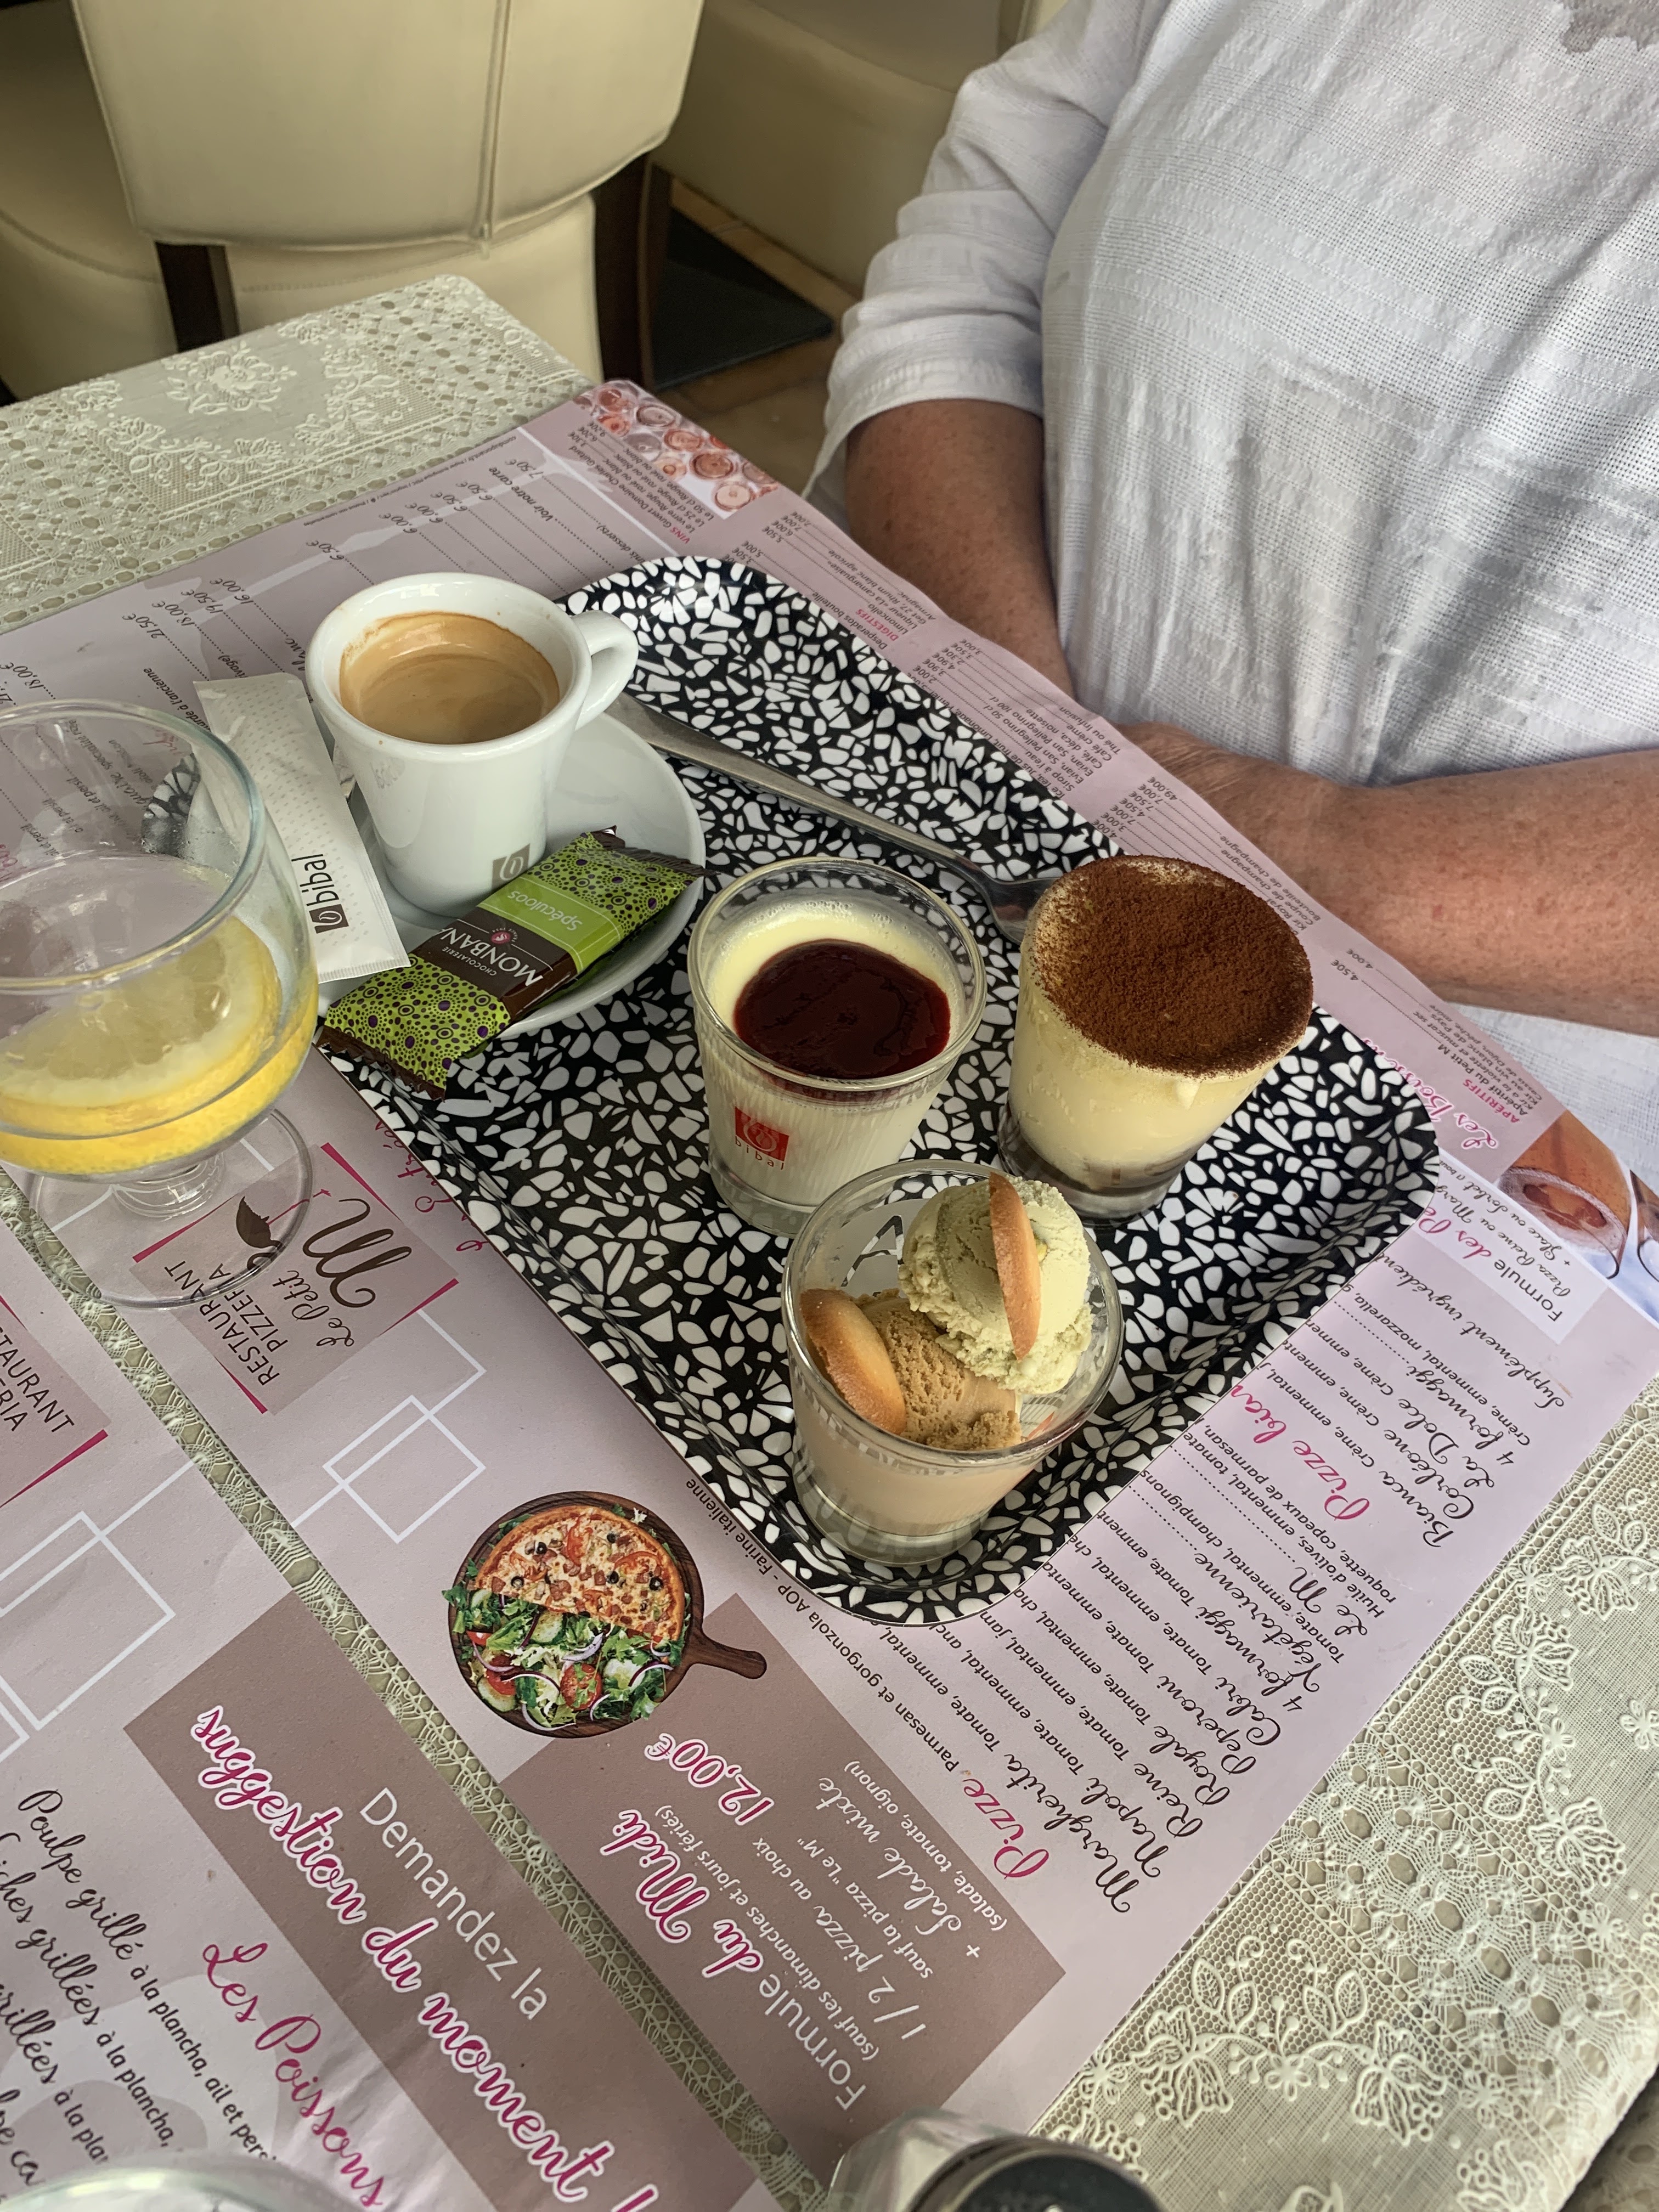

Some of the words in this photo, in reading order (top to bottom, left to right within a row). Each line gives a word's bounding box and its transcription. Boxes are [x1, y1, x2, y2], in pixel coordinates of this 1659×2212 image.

[488, 467, 514, 489] carte
[510, 483, 538, 508] notre
[532, 505, 553, 522] Voir
[843, 614, 888, 650] Desperados
[855, 608, 899, 643] DIGESTIFS
[1002, 718, 1043, 752] Pellegrino
[1012, 711, 1053, 744] Pellegrino
[1058, 706, 1093, 734] Infusion
[1042, 749, 1059, 764] San
[1052, 742, 1069, 757] San
[1081, 749, 1102, 769] Café,
[1092, 744, 1114, 764] Café
[1104, 740, 1121, 754] Thé
[1051, 771, 1075, 792] Sirop
[291, 854, 339, 906] bibal
[506, 878, 583, 932] Spéculoos
[441, 942, 497, 977] CHOCOLATERIE
[1330, 959, 1358, 981] 4,50€
[1451, 1053, 1474, 1074] Petit
[1463, 1079, 1520, 1123] APÉRITIFS
[1488, 1085, 1528, 1115] Apéritif
[735, 1135, 785, 1170] bibal
[1451, 1111, 1499, 1152] Les
[1462, 1181, 1508, 1214] Sorbet
[300, 1196, 413, 1310] M
[1456, 1229, 1492, 1260] des
[1497, 1232, 1535, 1266] Reine
[271, 1269, 330, 1322] Petit
[1493, 1259, 1563, 1322] Formule
[1537, 1263, 1571, 1297] Pizza
[314, 1317, 355, 1348] Le
[1353, 1292, 1422, 1351] mozzarella,
[1352, 1357, 1393, 1396] Crème,
[1421, 1349, 1488, 1406] emmental,
[1458, 1320, 1565, 1409] Supplément
[1266, 1368, 1332, 1426] emmental,
[1338, 1386, 1380, 1426] Crème,
[1404, 1364, 1504, 1451] formaggi
[1333, 1425, 1375, 1468] Crème,
[1396, 1397, 1459, 1465] Dolce
[1490, 1404, 1531, 1446] Crème,
[1203, 1424, 1269, 1485] parmesan,
[1289, 1439, 1370, 1522] Pizze
[1381, 1429, 1475, 1520] Corléone
[1460, 1455, 1495, 1489] La
[685, 1478, 737, 1536] italienne
[1227, 1472, 1296, 1536] emmental,
[1265, 1484, 1283, 1500] de
[1376, 1470, 1454, 1548] Bianca
[1281, 1500, 1336, 1550] copeaux
[735, 1532, 773, 1575] Farine
[1297, 1535, 1347, 1583] d'olives,
[1339, 1549, 1397, 1603] roquette,
[777, 1584, 810, 1612] AOP
[1090, 1556, 1160, 1622] emmental,
[1148, 1557, 1195, 1607] Tomate,
[1221, 1547, 1292, 1616] emmental,
[1287, 1566, 1328, 1613] M
[1346, 1583, 1385, 1618] Huile
[1104, 1620, 1155, 1674] Tomate,
[1171, 1552, 1340, 1693] Végétarienne
[1294, 1611, 1345, 1664] Tomate,
[1332, 1604, 1368, 1638] Le
[808, 1610, 883, 1687] gorgonzola
[878, 1623, 949, 1695] emmental,
[1004, 1636, 1076, 1705] emmental,
[1161, 1621, 1212, 1675] Tomate,
[1193, 1605, 1299, 1697] formaggi
[877, 1686, 895, 1703] et
[1103, 1673, 1151, 1725] Tomate,
[1212, 1676, 1282, 1747] Cabri
[893, 1702, 960, 1772] Parmesan
[949, 1695, 1001, 1752] Tomate,
[1032, 1718, 1085, 1775] Tomate,
[1077, 1705, 1130, 1761] Tomate,
[1154, 1674, 1260, 1776] Peperoni
[644, 1729, 775, 1828] 12,00€
[843, 1760, 899, 1814] oignon)
[1147, 1724, 1231, 1807] Royale
[814, 1776, 881, 1844] mixte
[1131, 1762, 1204, 1839] Reine
[654, 1804, 703, 1852] fériés)
[900, 1813, 952, 1872] tomate,
[932, 1778, 1050, 1881] Pizze
[977, 1753, 1159, 1914] Margherita
[1076, 1776, 1178, 1878] Napoli
[16, 1788, 88, 1884] Poulpe
[65, 1886, 148, 1961] grillé
[597, 1808, 712, 1944] Midi
[696, 1850, 740, 1892] jours
[751, 1837, 792, 1878] choix
[359, 1786, 519, 1982] Demandez
[510, 1967, 549, 2021] la
[728, 1887, 748, 1906] et
[789, 1878, 812, 1900] au
[844, 1881, 890, 1925] pizza
[875, 1847, 962, 1937] Salade
[952, 1870, 1007, 1931] (salade,
[191, 1705, 367, 1926] suggestion
[362, 1917, 437, 1994] du
[419, 1991, 614, 2202] moment
[699, 1917, 764, 1980] du
[745, 1906, 821, 1990] dimanches
[812, 1904, 883, 1973] pizza
[882, 1923, 901, 1945] la
[893, 1941, 933, 1978] sauf
[14, 1926, 103, 2027] grillées
[140, 1978, 160, 2000] la
[817, 1990, 842, 2019] les
[106, 2045, 126, 2068] la
[148, 2001, 208, 2078] plancha,
[757, 1973, 867, 2109] Formule
[833, 2015, 879, 2061] (sauf
[200, 1939, 272, 2023] Les
[255, 2013, 386, 2209] Poissons
[205, 2077, 232, 2103] ail
[114, 2068, 175, 2147] plancha,
[222, 2103, 244, 2124] et
